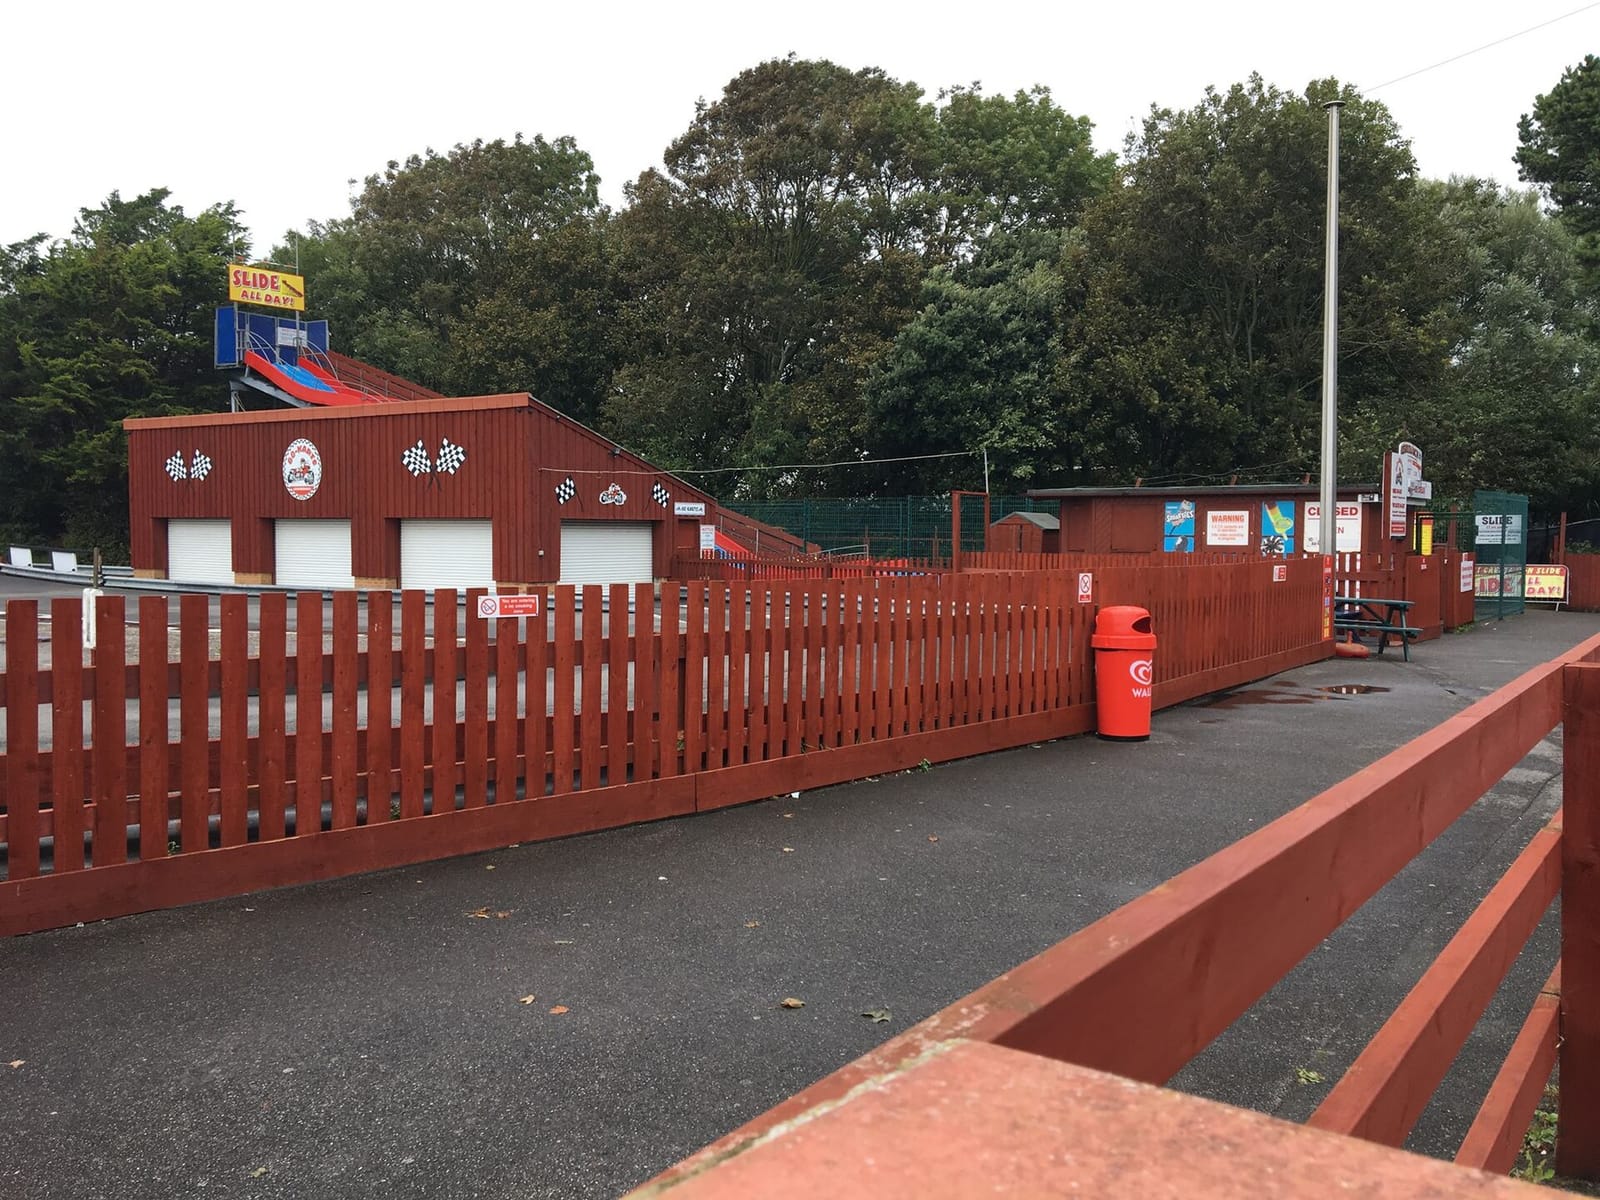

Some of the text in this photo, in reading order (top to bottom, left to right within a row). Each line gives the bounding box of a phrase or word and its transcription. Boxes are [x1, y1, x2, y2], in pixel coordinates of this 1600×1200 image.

[233, 270, 279, 291] SLIDE
[241, 290, 294, 306] ALL DAY!
[1307, 506, 1358, 516] CLSED
[1211, 514, 1245, 523] WARNING
[1536, 567, 1561, 575] SLIDE
[1526, 586, 1561, 595] DAY!
